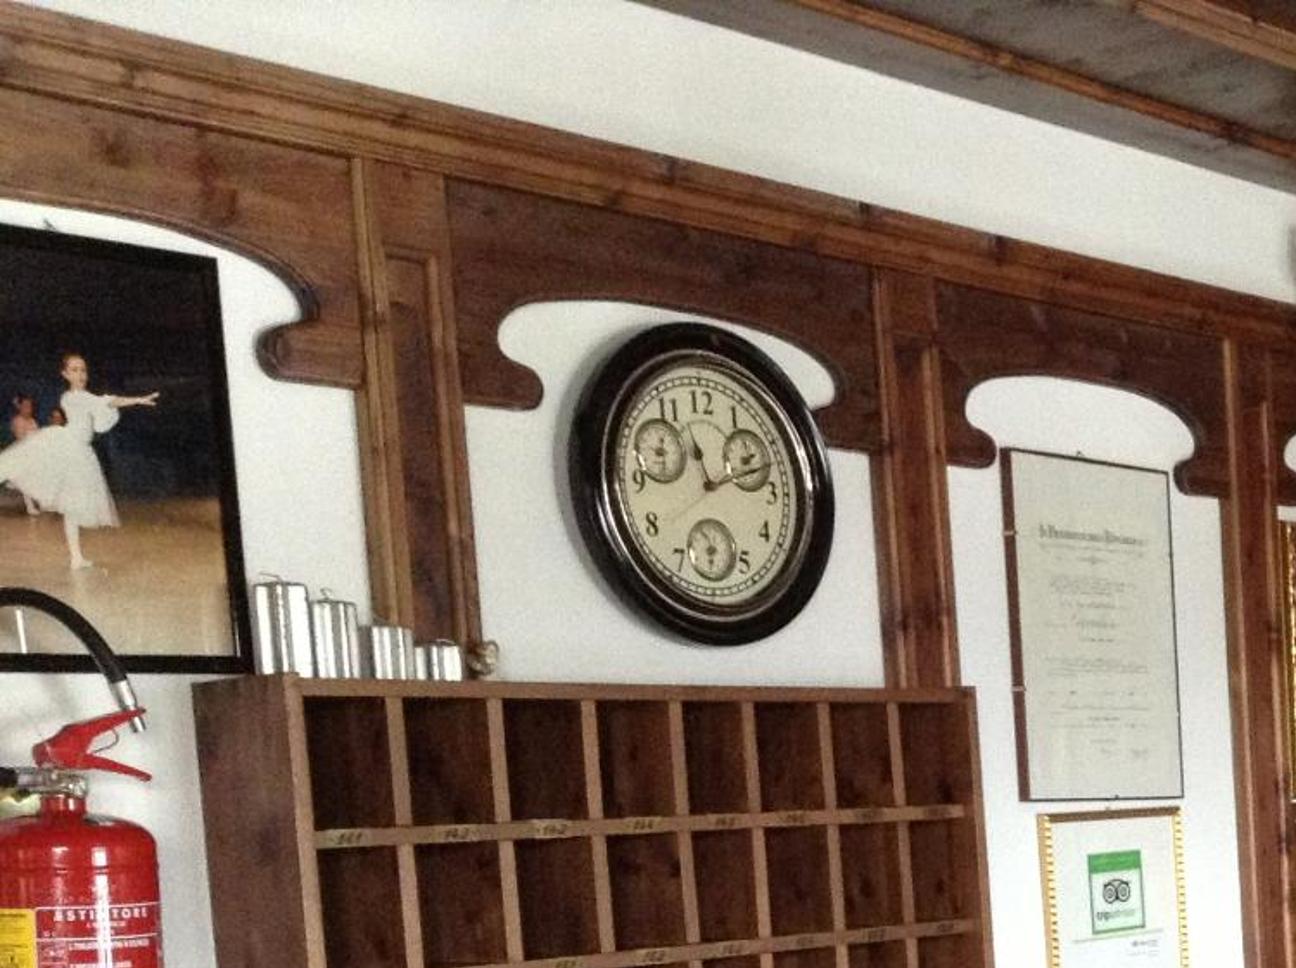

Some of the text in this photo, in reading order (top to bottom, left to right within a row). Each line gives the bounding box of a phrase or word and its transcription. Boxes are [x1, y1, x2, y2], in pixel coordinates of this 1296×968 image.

[658, 397, 679, 422] 11
[689, 391, 713, 416] 12
[730, 405, 738, 428] 1
[633, 470, 646, 494] 9
[767, 481, 778, 505] 3
[645, 511, 659, 538] 8
[758, 520, 770, 543] 4
[673, 547, 685, 573] 7
[738, 550, 750, 575] 5
[53, 906, 148, 922] ESTITORE
